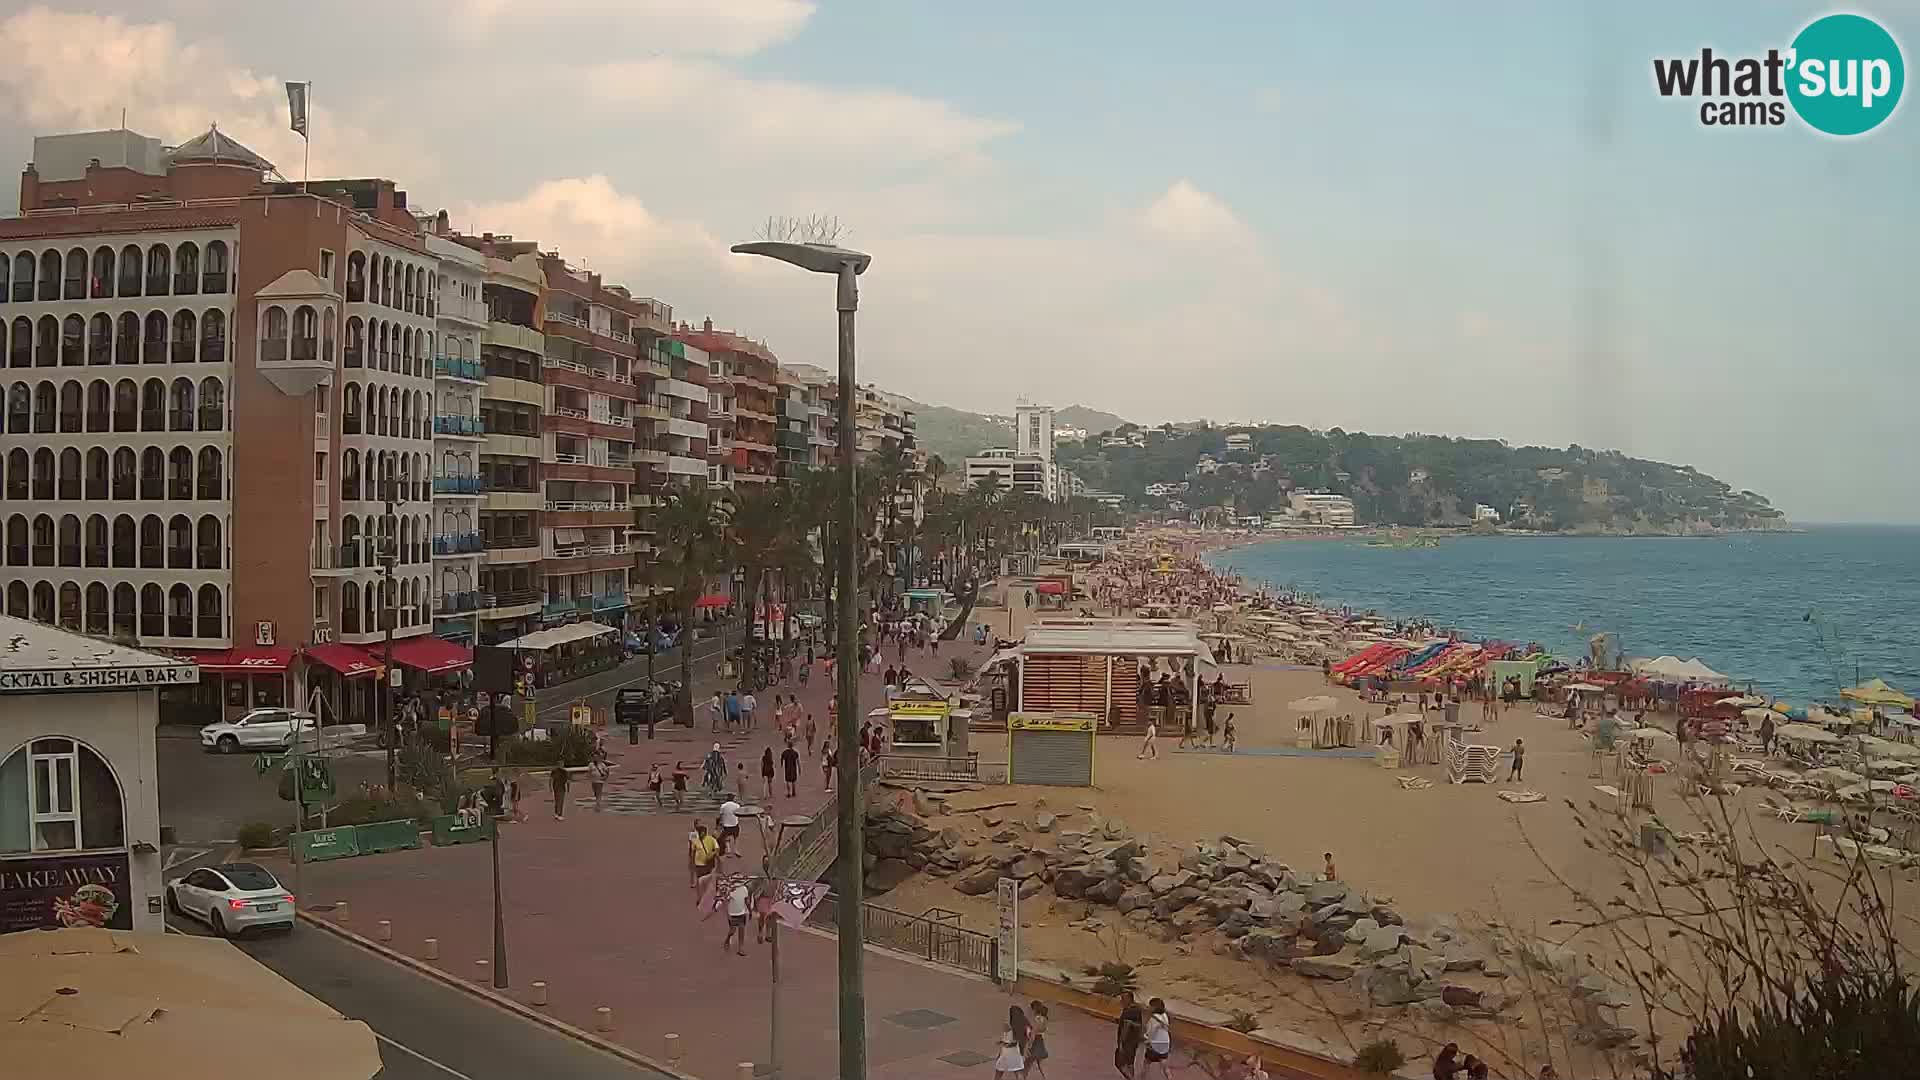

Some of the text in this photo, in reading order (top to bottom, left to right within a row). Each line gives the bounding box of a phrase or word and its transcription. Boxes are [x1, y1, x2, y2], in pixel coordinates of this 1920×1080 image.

[313, 628, 332, 645] KFC
[240, 657, 277, 665] KFC
[79, 668, 141, 686] SHISHA
[145, 668, 178, 682] BAR
[0, 865, 121, 889] TAKEAWAY
